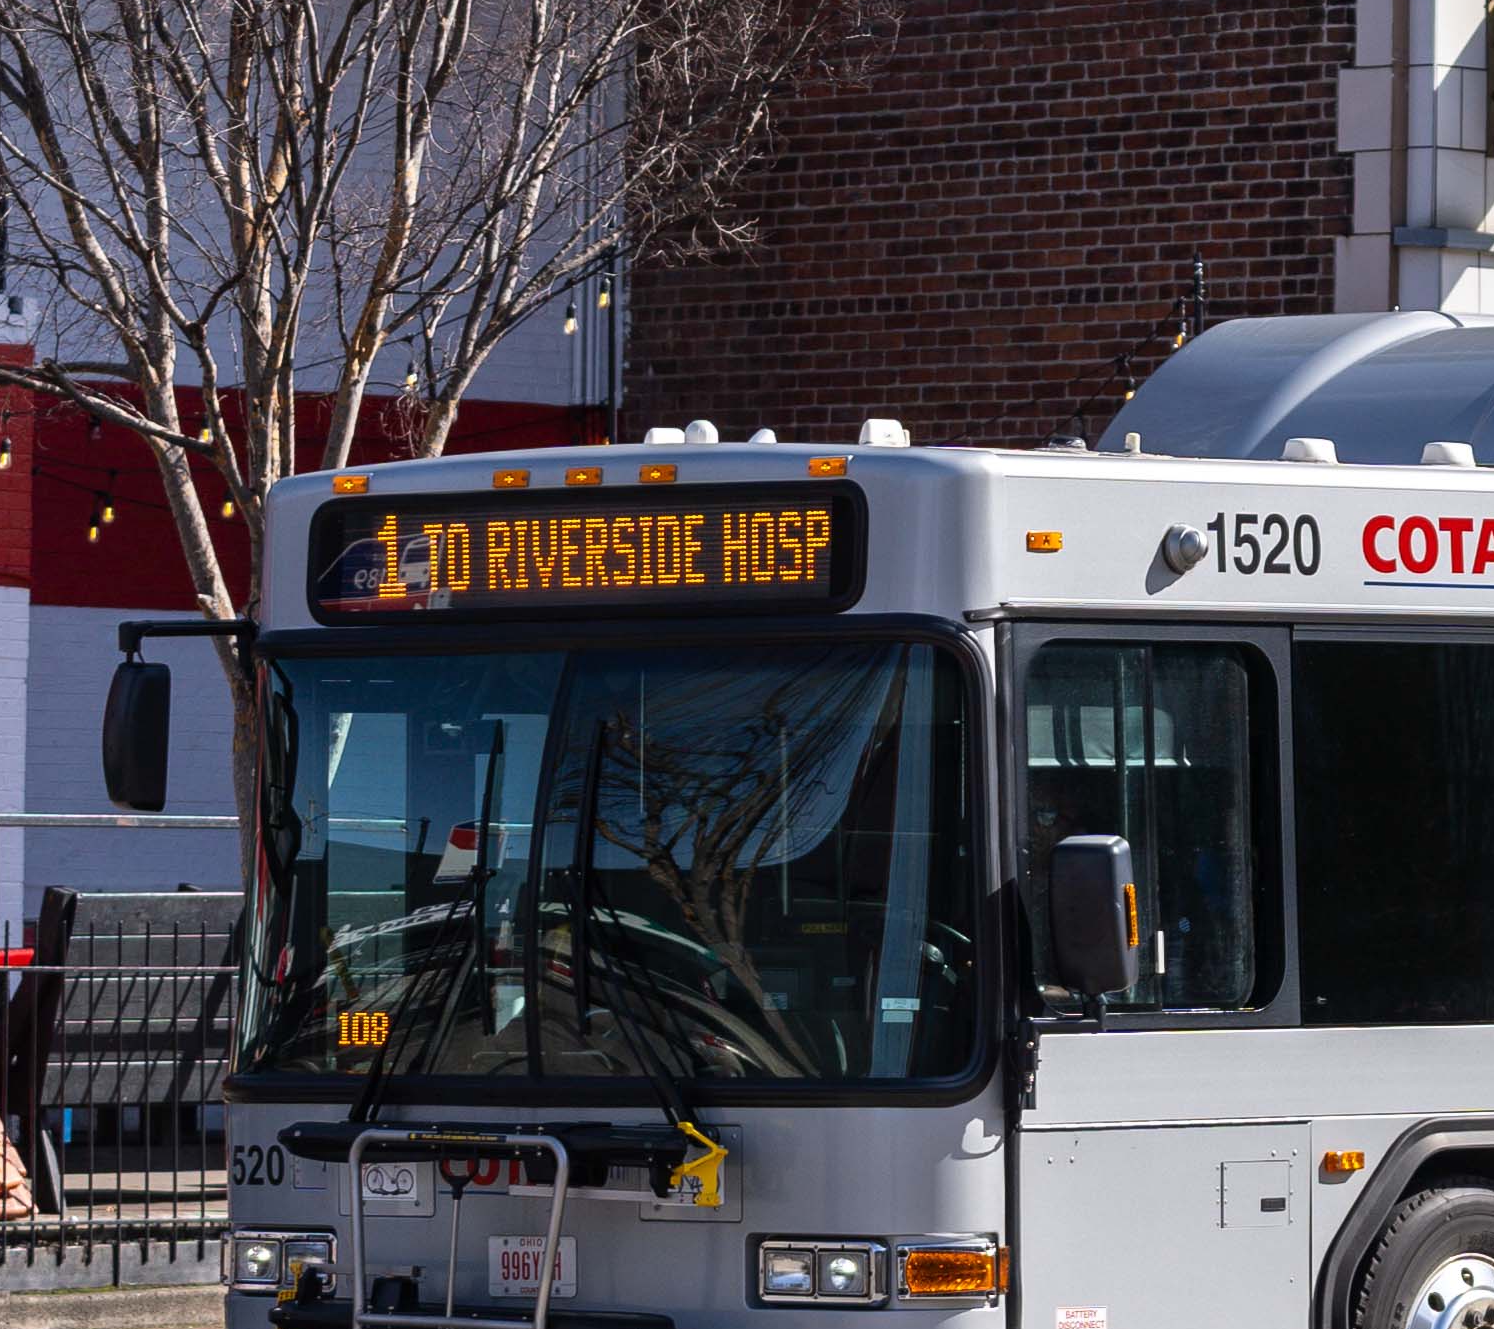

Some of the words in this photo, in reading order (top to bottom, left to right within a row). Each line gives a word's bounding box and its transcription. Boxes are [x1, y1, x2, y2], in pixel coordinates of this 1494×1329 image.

[377, 515, 407, 599] 1
[423, 522, 470, 591] TO
[487, 514, 705, 590] RIVERSIDE
[722, 510, 832, 584] HOSP
[1207, 512, 1322, 576] 1520
[338, 1012, 389, 1046] 108
[520, 1238, 543, 1247] OHIO
[1065, 1310, 1098, 1319] BATTERY
